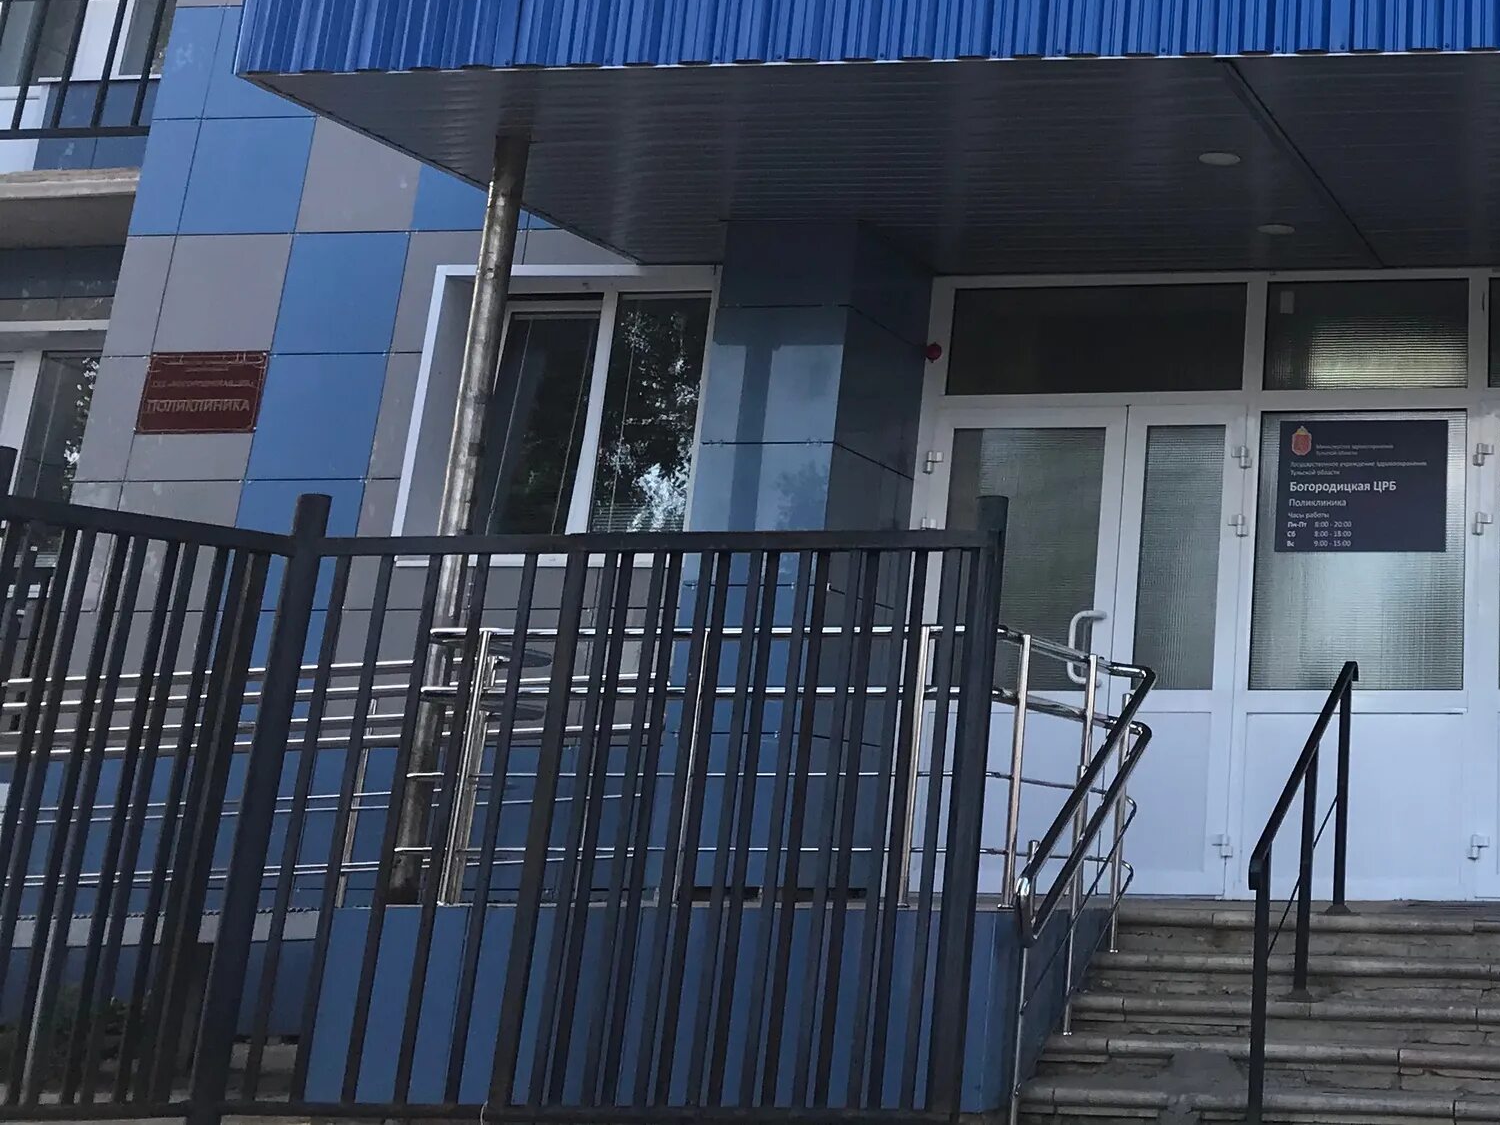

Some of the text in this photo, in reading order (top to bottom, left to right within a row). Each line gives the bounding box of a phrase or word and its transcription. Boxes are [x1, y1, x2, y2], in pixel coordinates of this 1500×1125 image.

[146, 398, 250, 412] ПОЛИКЛИНИКА
[1289, 480, 1397, 494] Богородицкая ЦРБ
[1288, 498, 1347, 507] Поликлиника
[1305, 511, 1330, 519] работы
